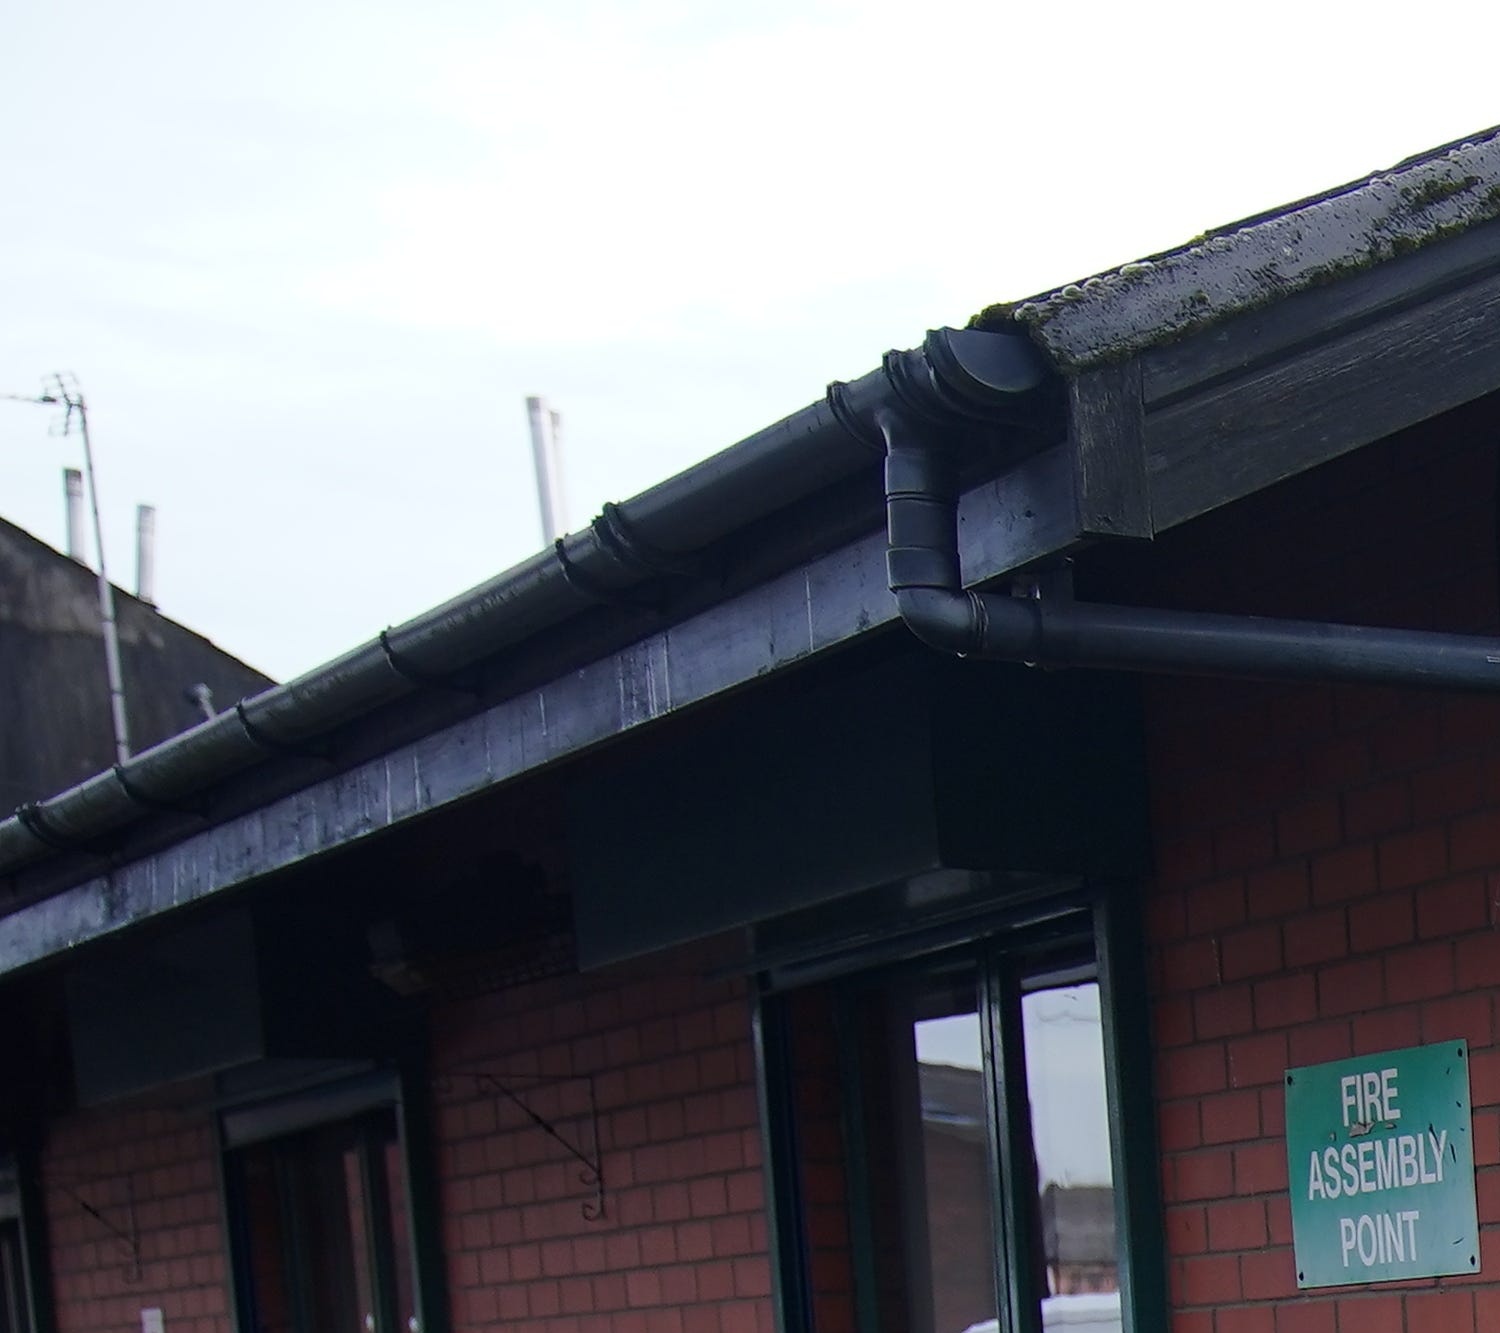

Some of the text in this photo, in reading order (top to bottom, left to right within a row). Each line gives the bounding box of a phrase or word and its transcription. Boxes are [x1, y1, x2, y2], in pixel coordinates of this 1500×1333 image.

[1341, 1068, 1400, 1127] FIRE
[1308, 1130, 1448, 1200] ASSEMBLY
[1340, 1211, 1419, 1267] POINT
